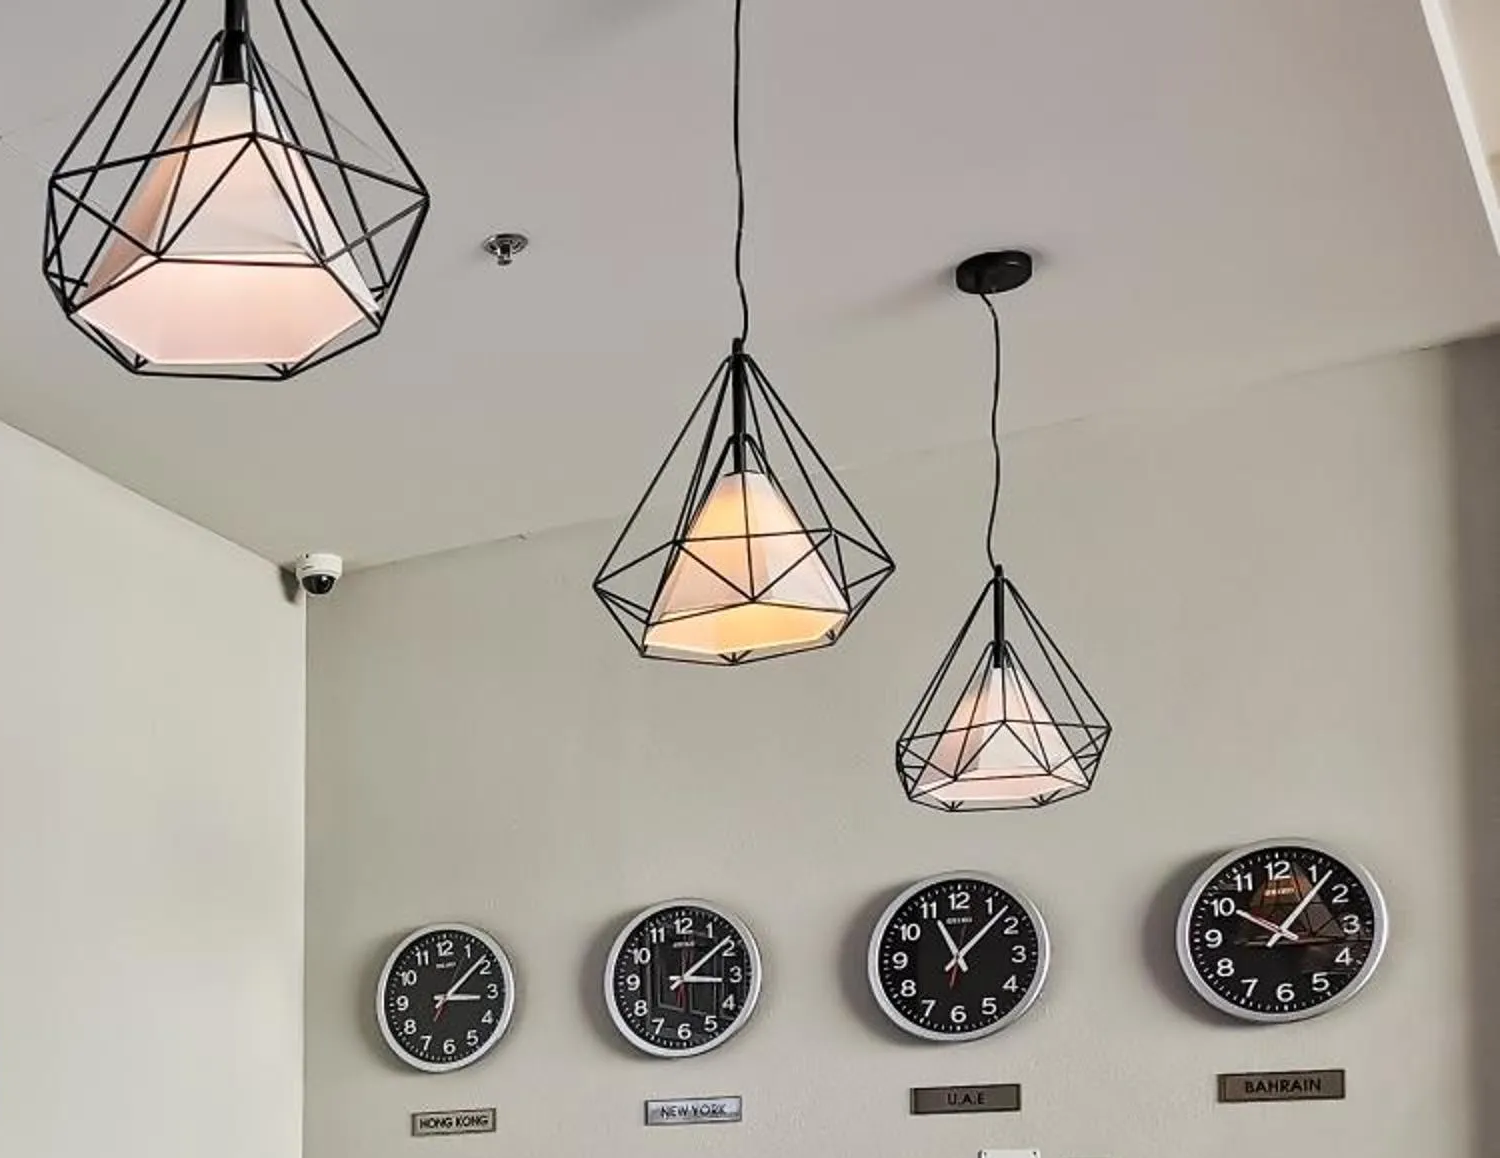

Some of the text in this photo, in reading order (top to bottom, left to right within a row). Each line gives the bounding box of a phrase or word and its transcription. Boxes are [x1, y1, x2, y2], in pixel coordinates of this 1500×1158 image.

[1265, 861, 1291, 879] 12
[1308, 866, 1317, 882] 1
[1234, 873, 1253, 892] 11
[948, 892, 970, 910] 12
[1332, 884, 1348, 902] 2
[920, 902, 937, 919] 11
[985, 898, 993, 914] 1
[1211, 898, 1235, 917] 10
[674, 918, 692, 935] 12
[706, 923, 713, 938] 1
[901, 924, 920, 941] 10
[1004, 917, 1019, 935] 2
[1343, 916, 1360, 933] 3
[651, 928, 666, 943] 11
[1205, 930, 1223, 948] 9
[437, 940, 453, 957] 12
[464, 944, 471, 958] 1
[633, 948, 650, 964] 10
[722, 942, 735, 957] 2
[1012, 946, 1026, 963] 3
[1335, 948, 1352, 965] 4
[416, 952, 429, 966] 11
[893, 952, 908, 969] 9
[1217, 958, 1234, 976] 8
[480, 960, 491, 975] 2
[730, 967, 742, 982] 3
[402, 971, 417, 986] 10
[626, 975, 640, 991] 9
[1003, 975, 1018, 992] 4
[1312, 973, 1329, 991] 5
[487, 984, 498, 999] 3
[901, 980, 916, 996] 8
[1241, 978, 1258, 998] 7
[1276, 984, 1294, 1001] 6
[396, 996, 409, 1011] 9
[634, 1000, 647, 1016] 8
[722, 995, 734, 1010] 4
[921, 1000, 936, 1017] 7
[982, 998, 997, 1014] 5
[482, 1010, 493, 1024] 4
[952, 1006, 966, 1022] 6
[404, 1020, 417, 1035] 8
[651, 1019, 664, 1035] 7
[678, 1024, 691, 1039] 6
[705, 1016, 718, 1032] 5
[420, 1036, 432, 1051] 7
[467, 1030, 479, 1045] 5
[443, 1039, 456, 1054] 6
[1245, 1079, 1321, 1093] BAHRAIN
[660, 1103, 727, 1118] NEW YORK
[420, 1116, 488, 1129] HONG KONG
